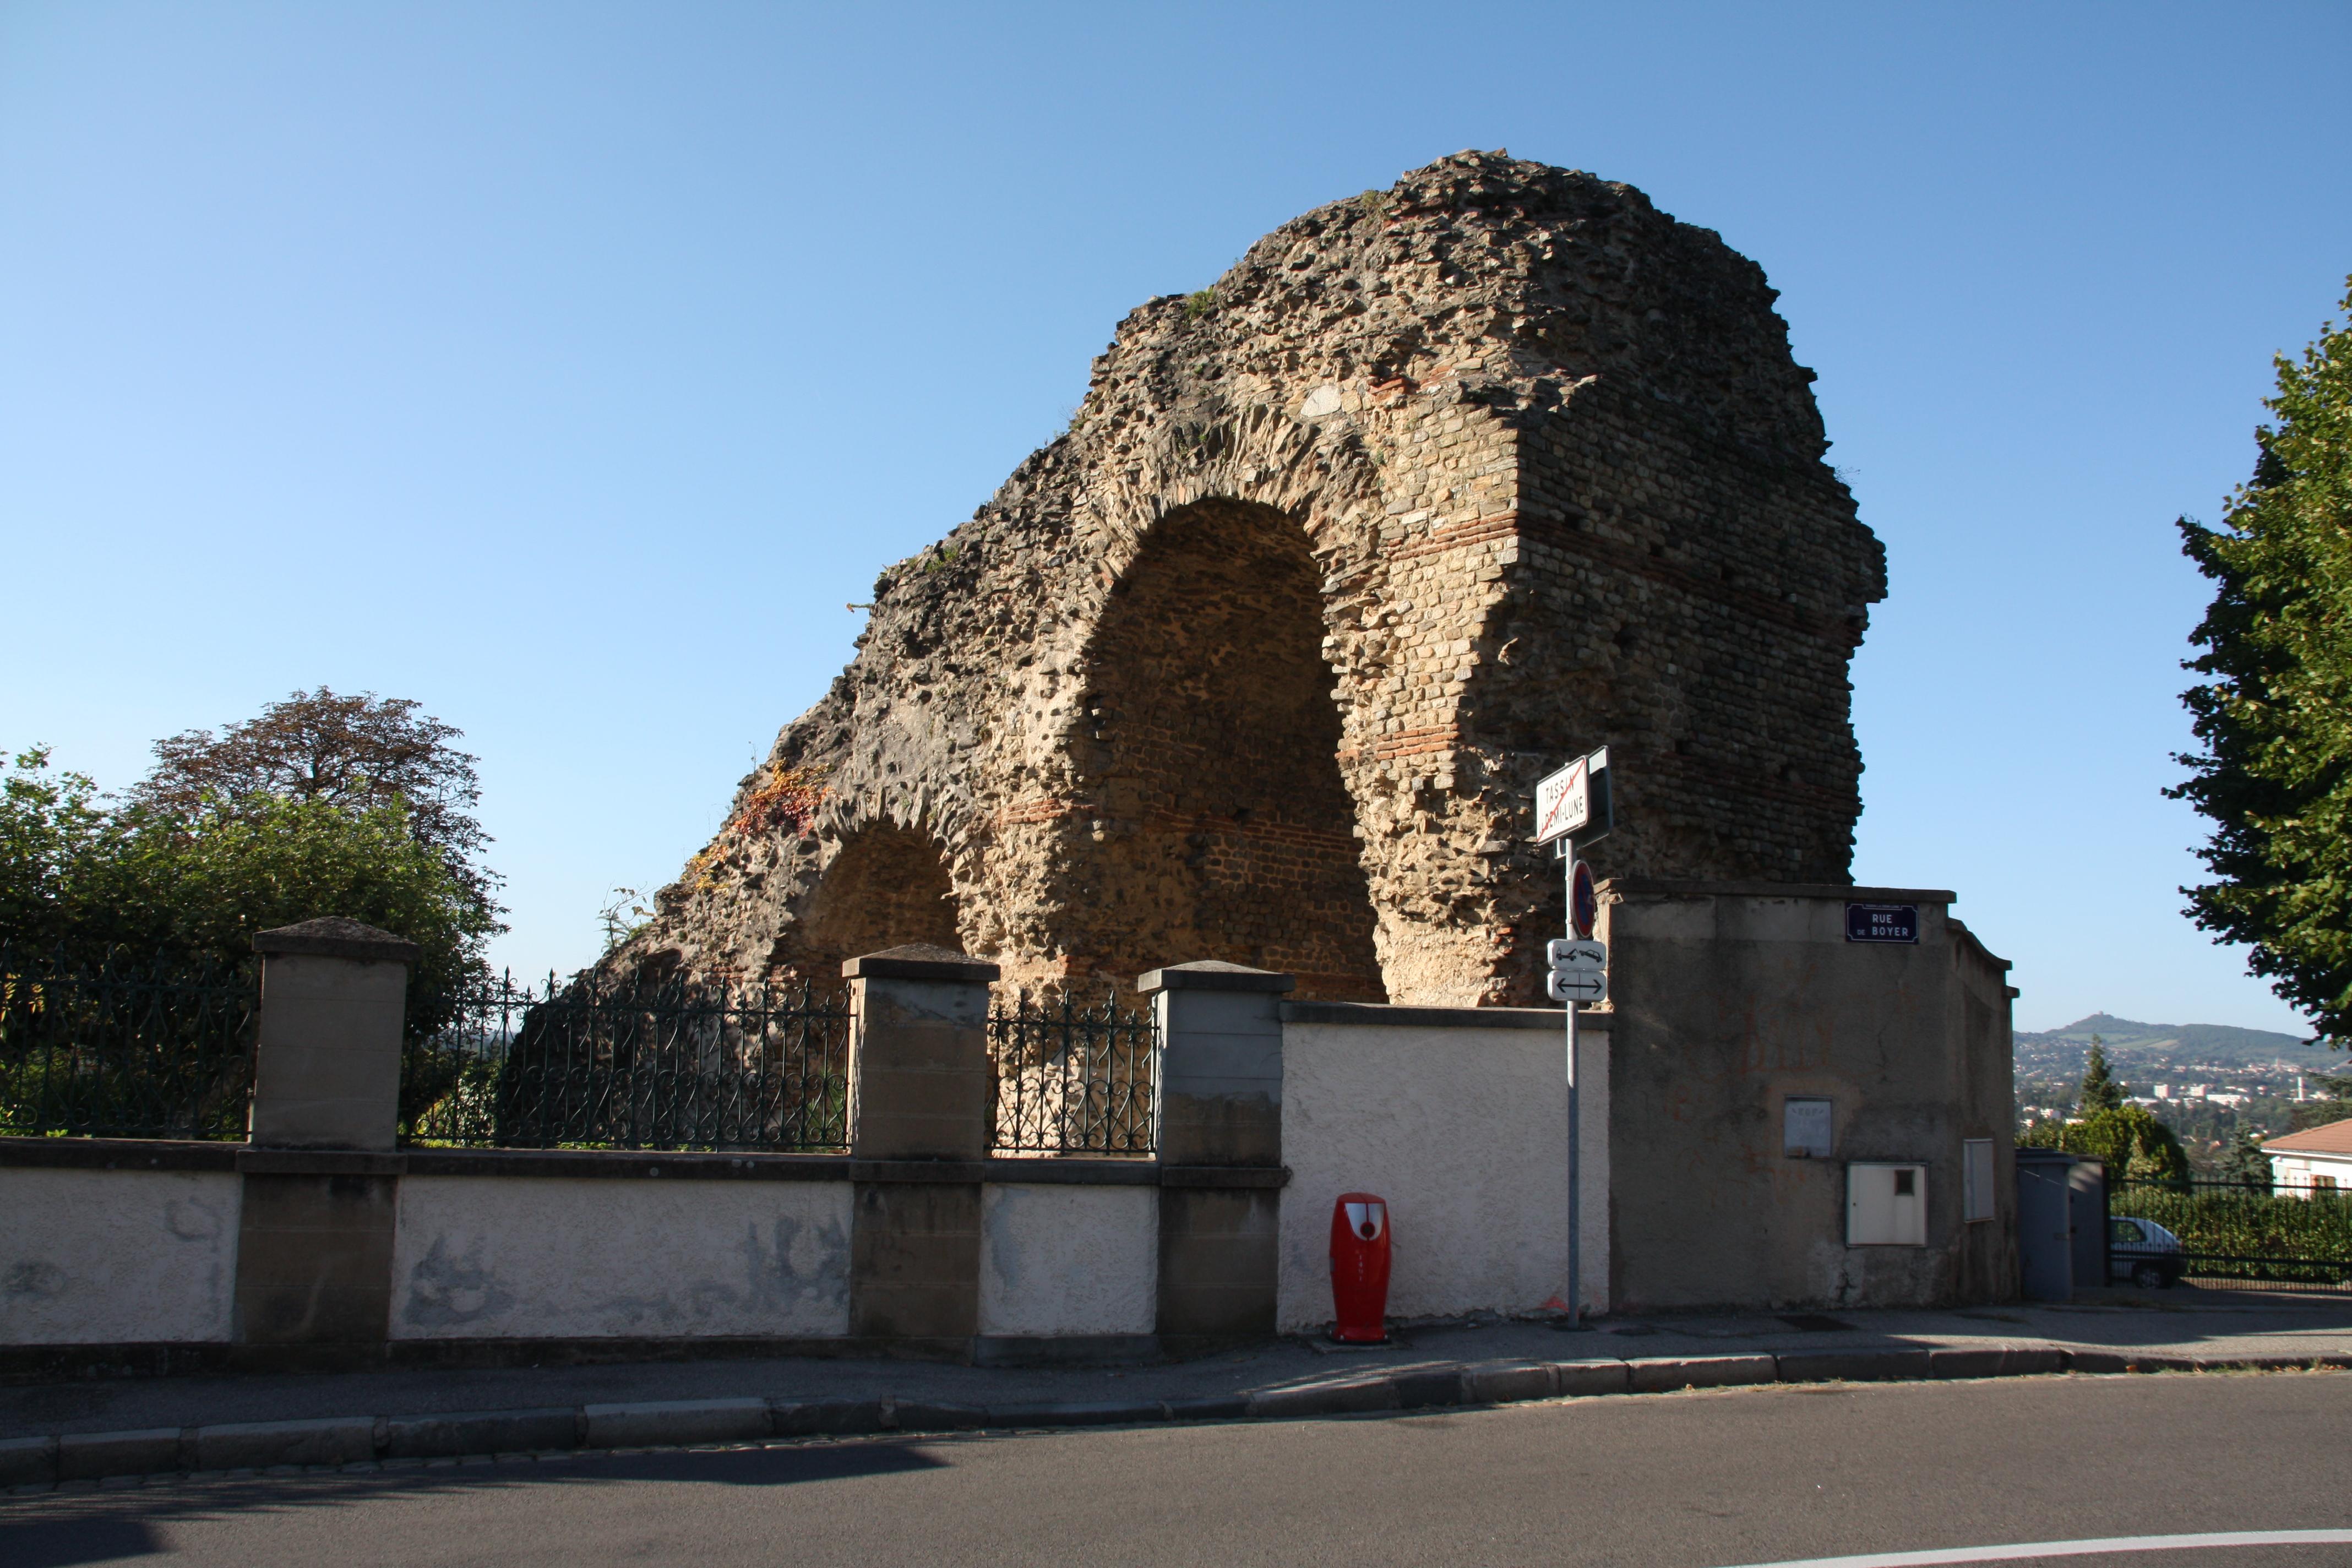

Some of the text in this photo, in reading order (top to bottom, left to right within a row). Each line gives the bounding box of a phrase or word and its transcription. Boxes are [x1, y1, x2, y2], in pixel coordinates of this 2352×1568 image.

[1546, 775, 1574, 804] TASSIN
[1545, 796, 1583, 830] DEMI-LUNE
[1872, 914, 1892, 923] RUE
[1872, 927, 1908, 936] BOYER
